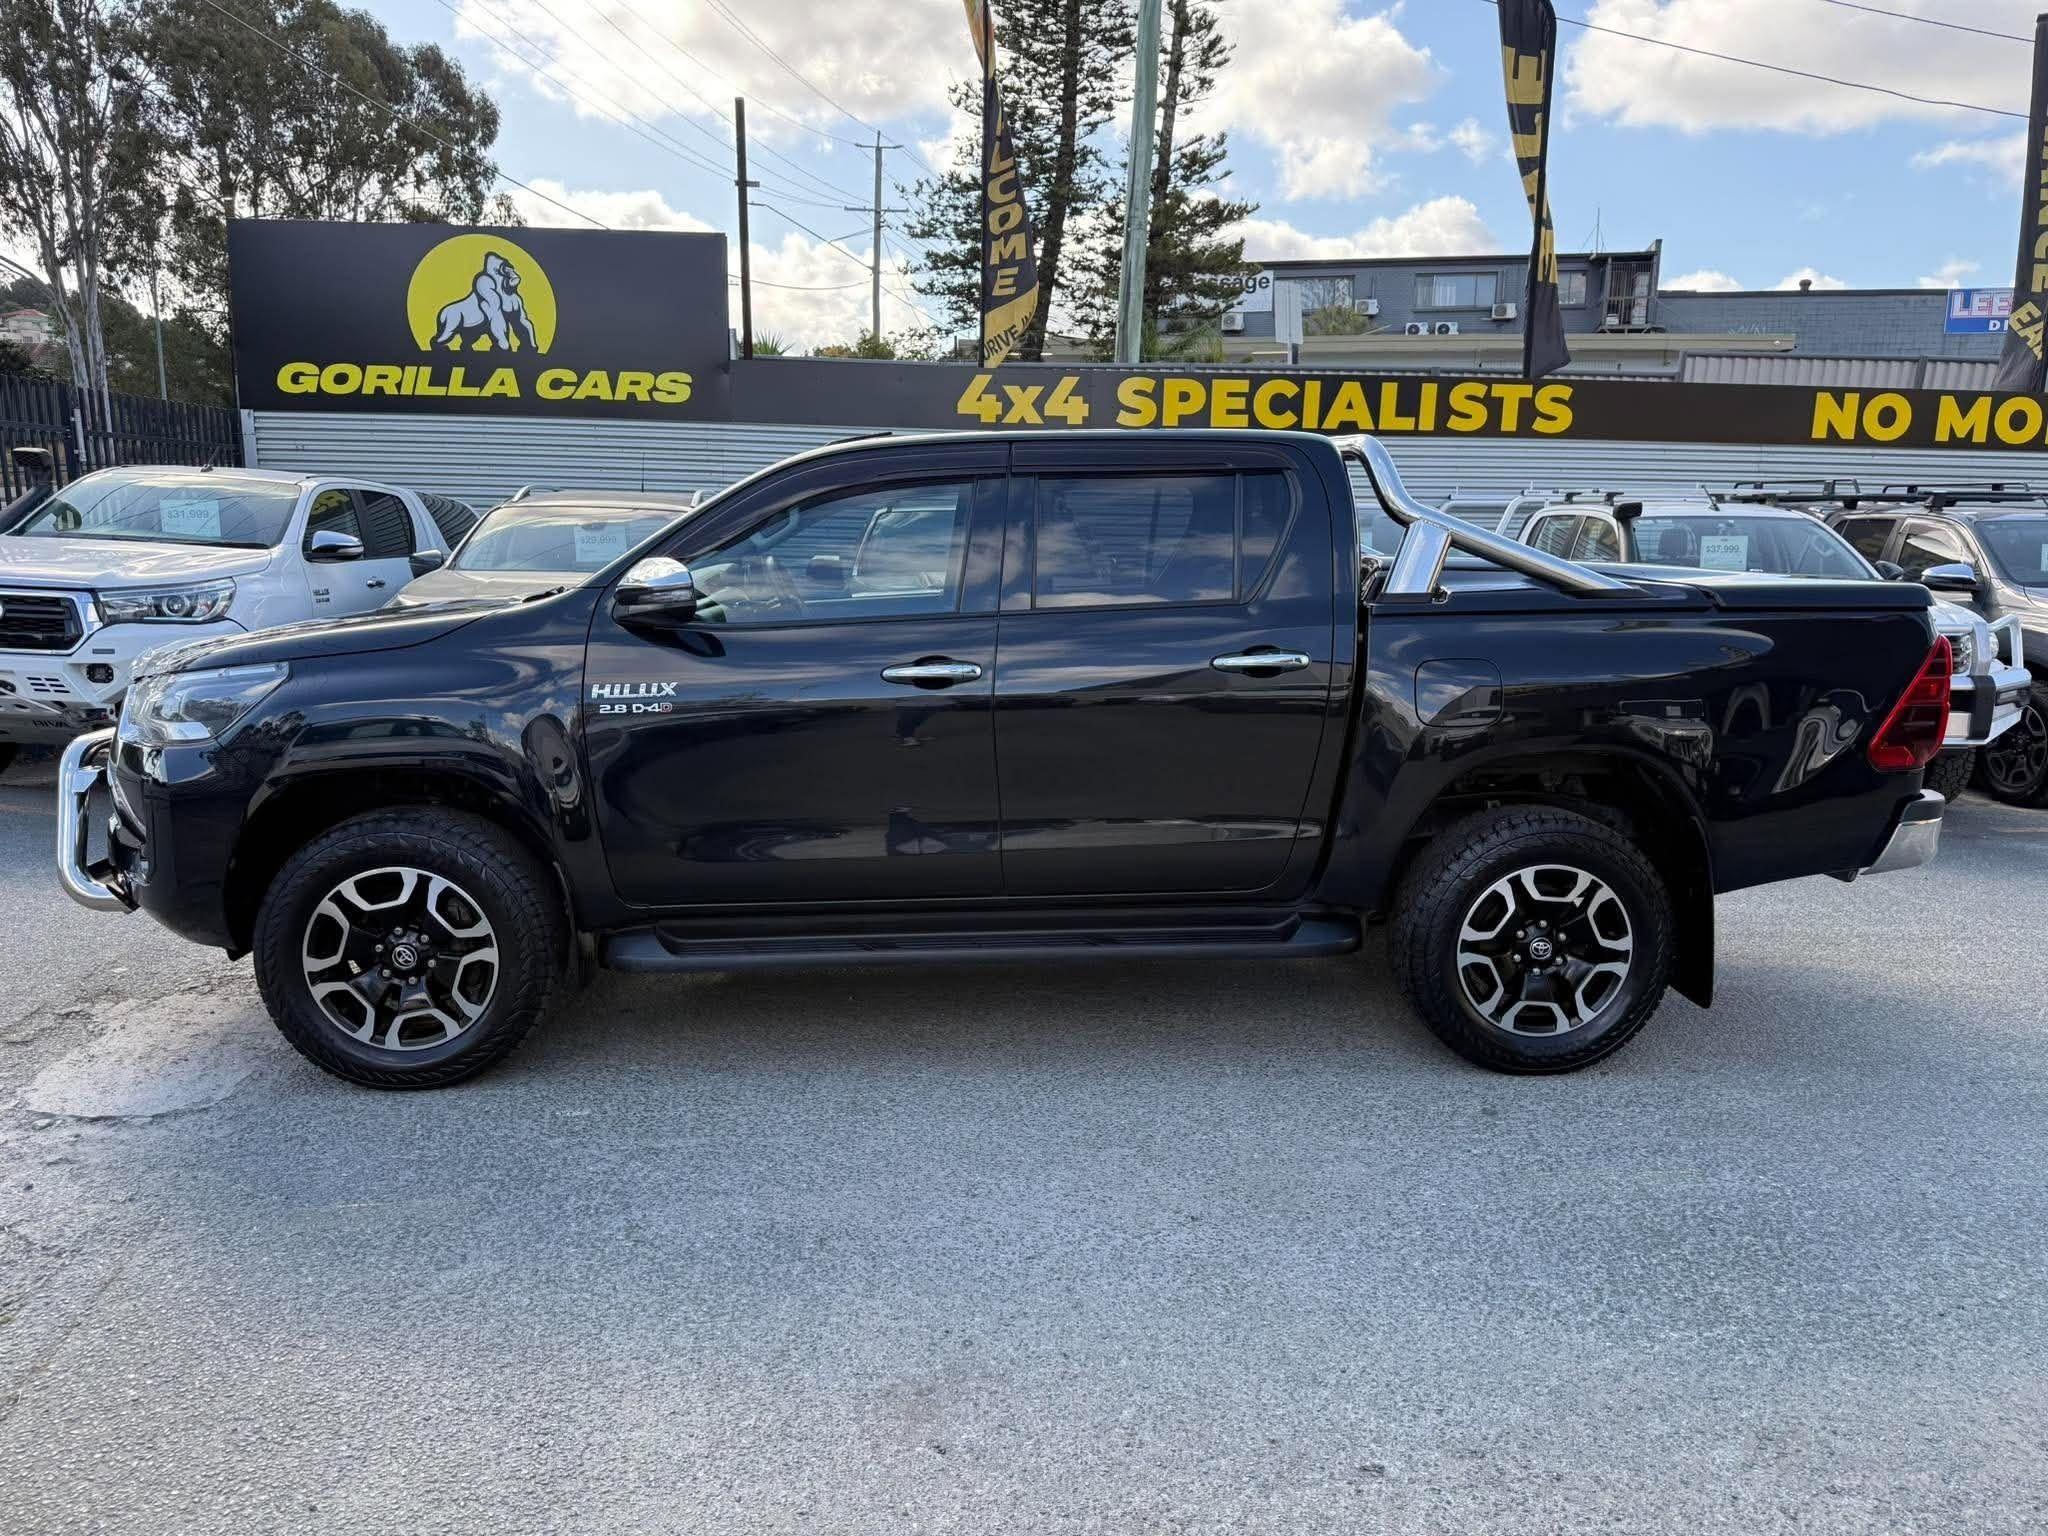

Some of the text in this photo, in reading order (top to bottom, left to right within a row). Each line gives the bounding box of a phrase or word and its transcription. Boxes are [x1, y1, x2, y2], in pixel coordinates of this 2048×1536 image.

[276, 362, 693, 403] GORILLA CARS
[957, 375, 1574, 435] 4x4 SPECIALISTS
[1811, 391, 2048, 445] NO MO
[592, 682, 678, 698] HILUX
